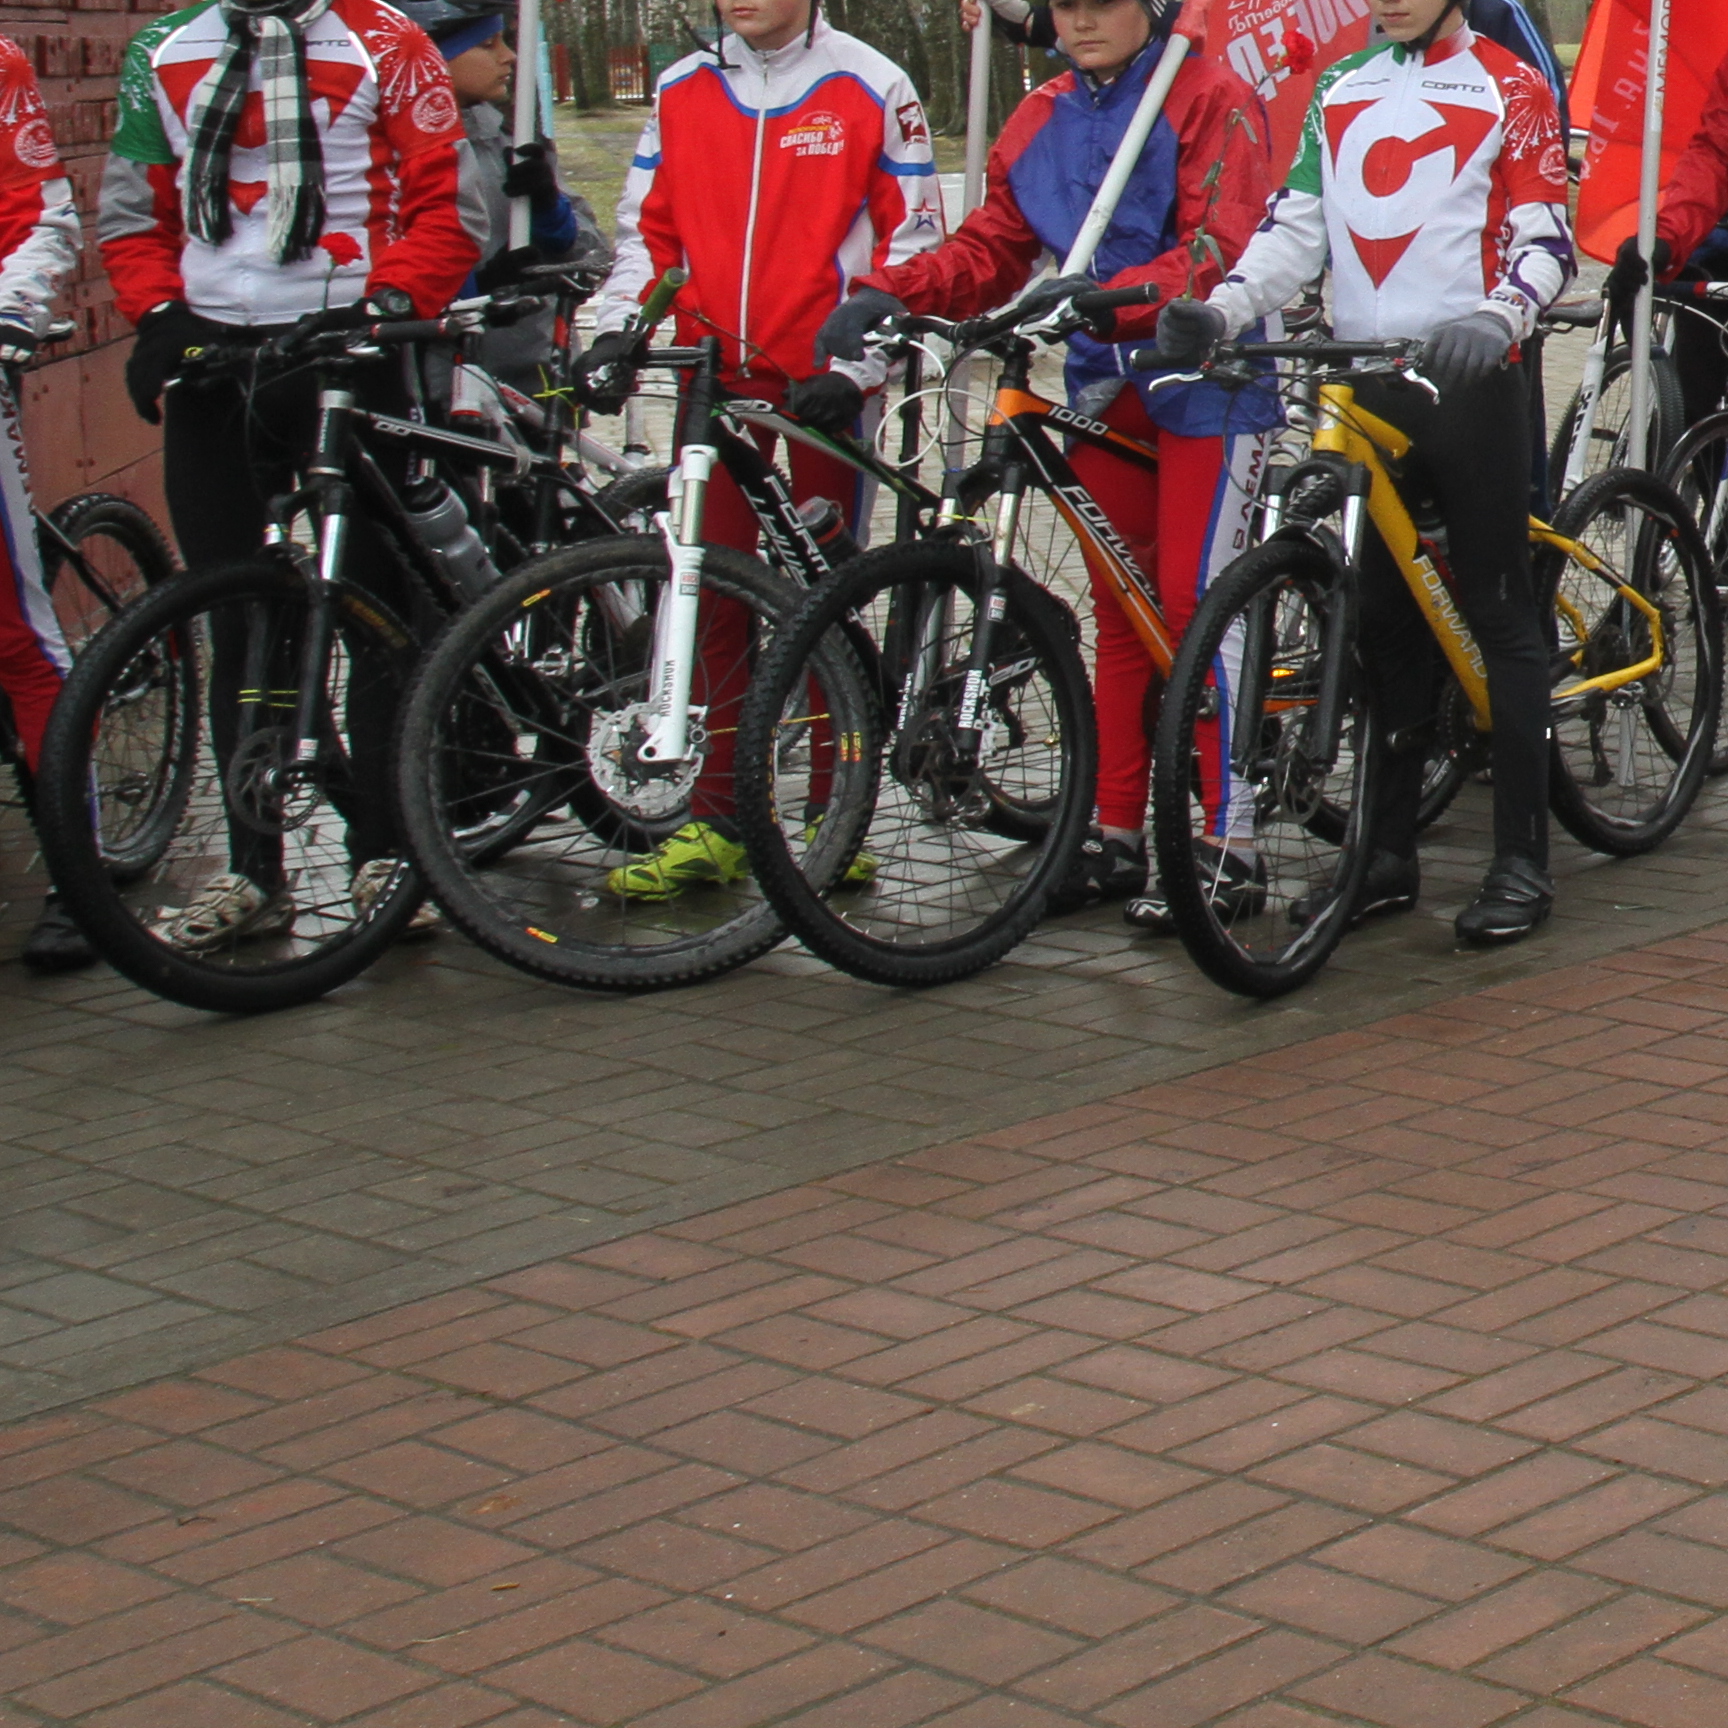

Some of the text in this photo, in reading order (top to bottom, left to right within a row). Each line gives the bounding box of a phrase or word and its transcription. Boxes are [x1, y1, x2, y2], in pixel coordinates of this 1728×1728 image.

[1421, 79, 1486, 94] CORTO
[780, 131, 824, 149] СПАСИБО
[1048, 403, 1109, 436] 1000
[958, 668, 983, 729] ROCKSHOX
